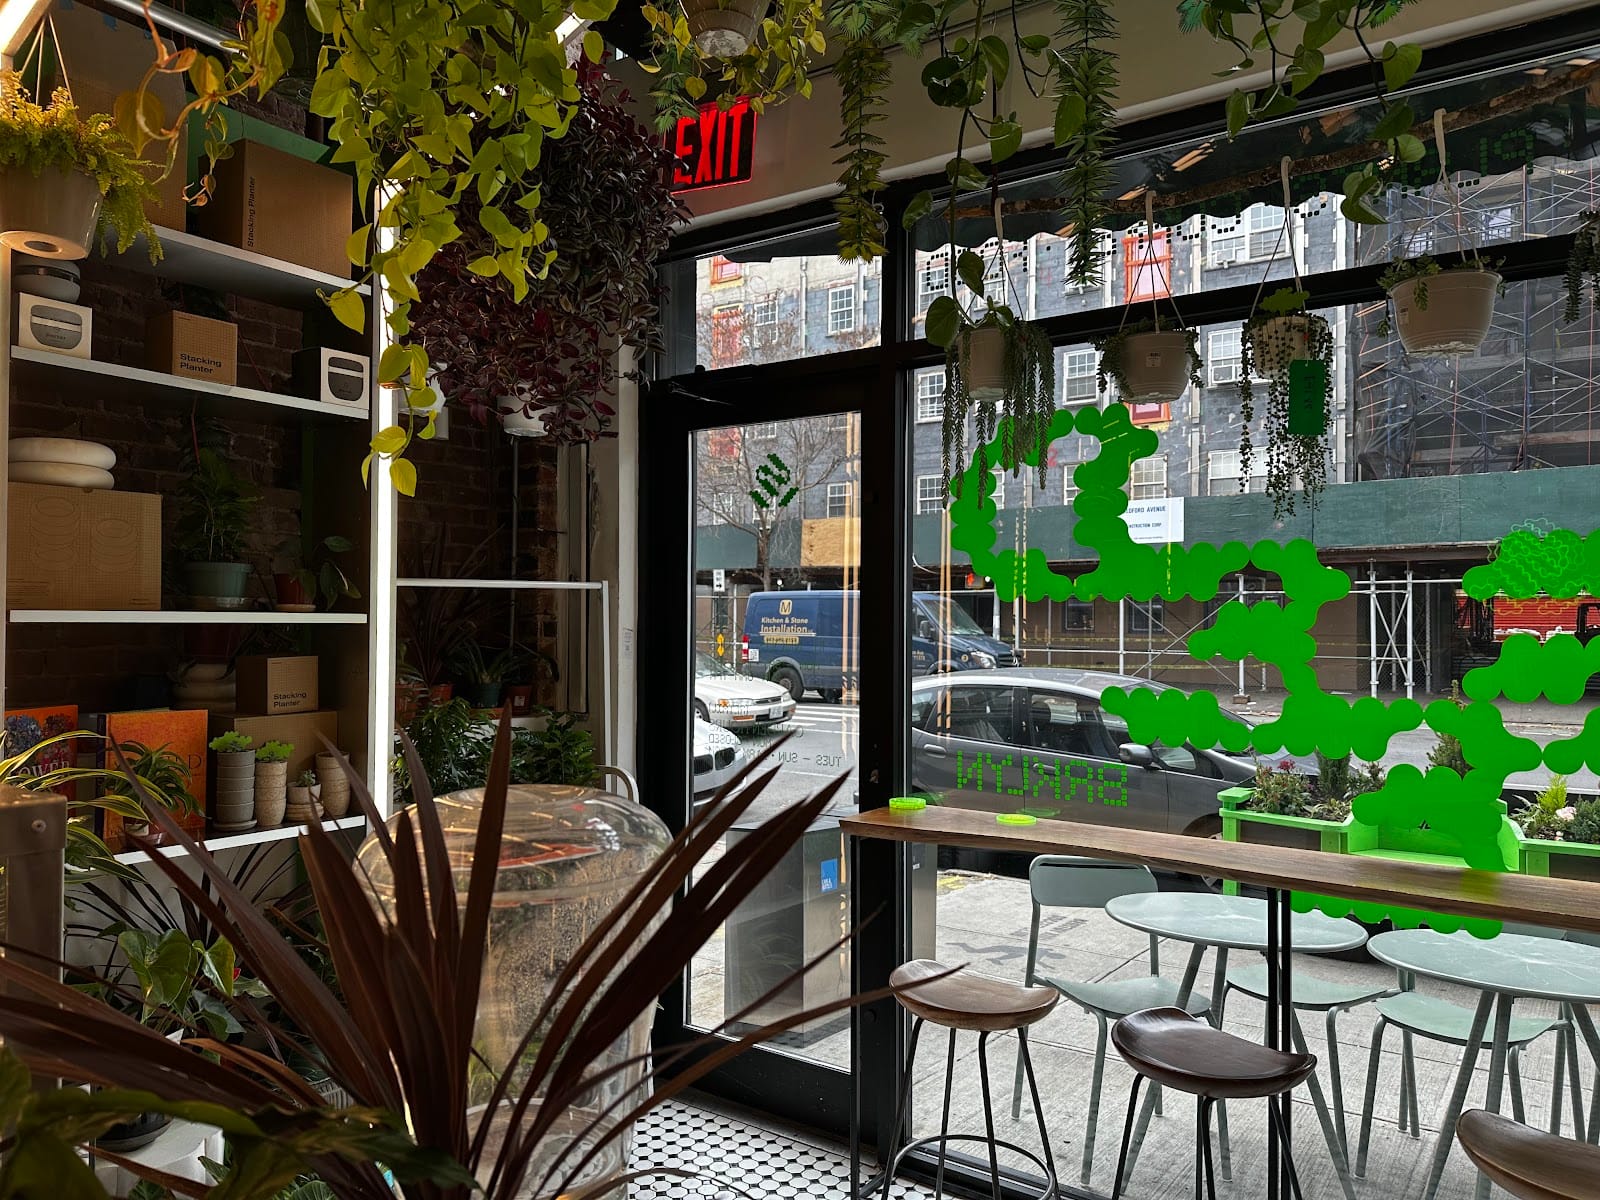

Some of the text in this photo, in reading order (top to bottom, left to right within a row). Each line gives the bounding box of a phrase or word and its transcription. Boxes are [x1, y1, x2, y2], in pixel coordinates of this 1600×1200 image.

[674, 103, 748, 185] EXIT
[247, 176, 256, 247] Stacking Planter
[180, 353, 222, 368] Stacking
[180, 362, 214, 374] Planter
[780, 602, 791, 613] M
[760, 624, 808, 633] Installation
[273, 691, 307, 700] Stacking
[273, 700, 301, 708] Planter
